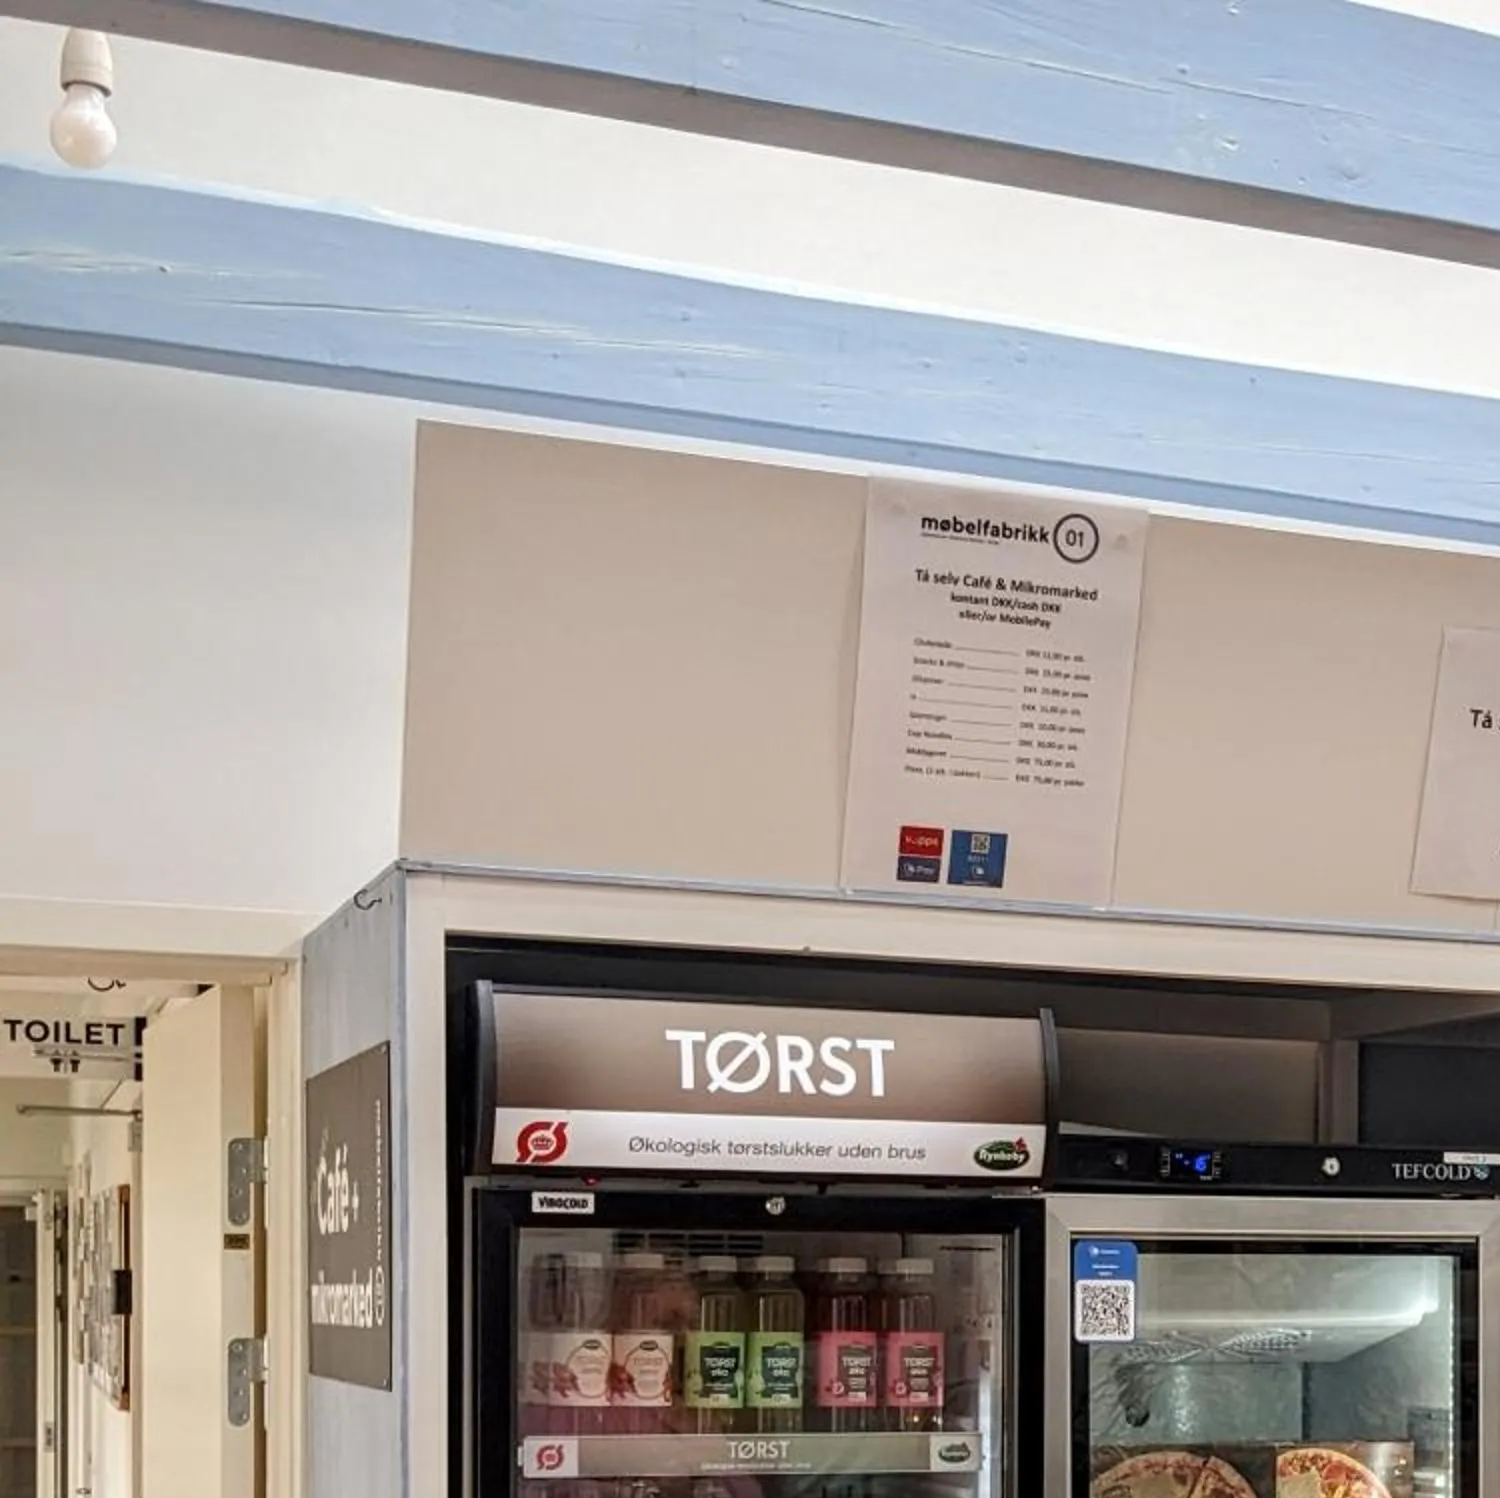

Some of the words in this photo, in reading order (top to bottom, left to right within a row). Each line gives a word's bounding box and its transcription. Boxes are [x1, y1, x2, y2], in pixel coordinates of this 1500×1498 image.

[920, 516, 1049, 544] møbelfabrikk
[933, 571, 960, 586] selv
[963, 575, 991, 590] Café
[995, 578, 1007, 591] &
[1010, 580, 1098, 601] Mikromarked
[1470, 709, 1492, 729] Tå
[4, 1019, 126, 1046] TOILET
[664, 1028, 895, 1098] TØRST
[628, 1135, 721, 1159] Økologisk
[727, 1139, 833, 1158] tørstslukker
[838, 1143, 882, 1160] uden
[886, 1143, 927, 1161] brus
[1391, 1163, 1472, 1181] TEFCOLD
[317, 1144, 349, 1236] Café
[727, 1440, 791, 1460] TØRST
